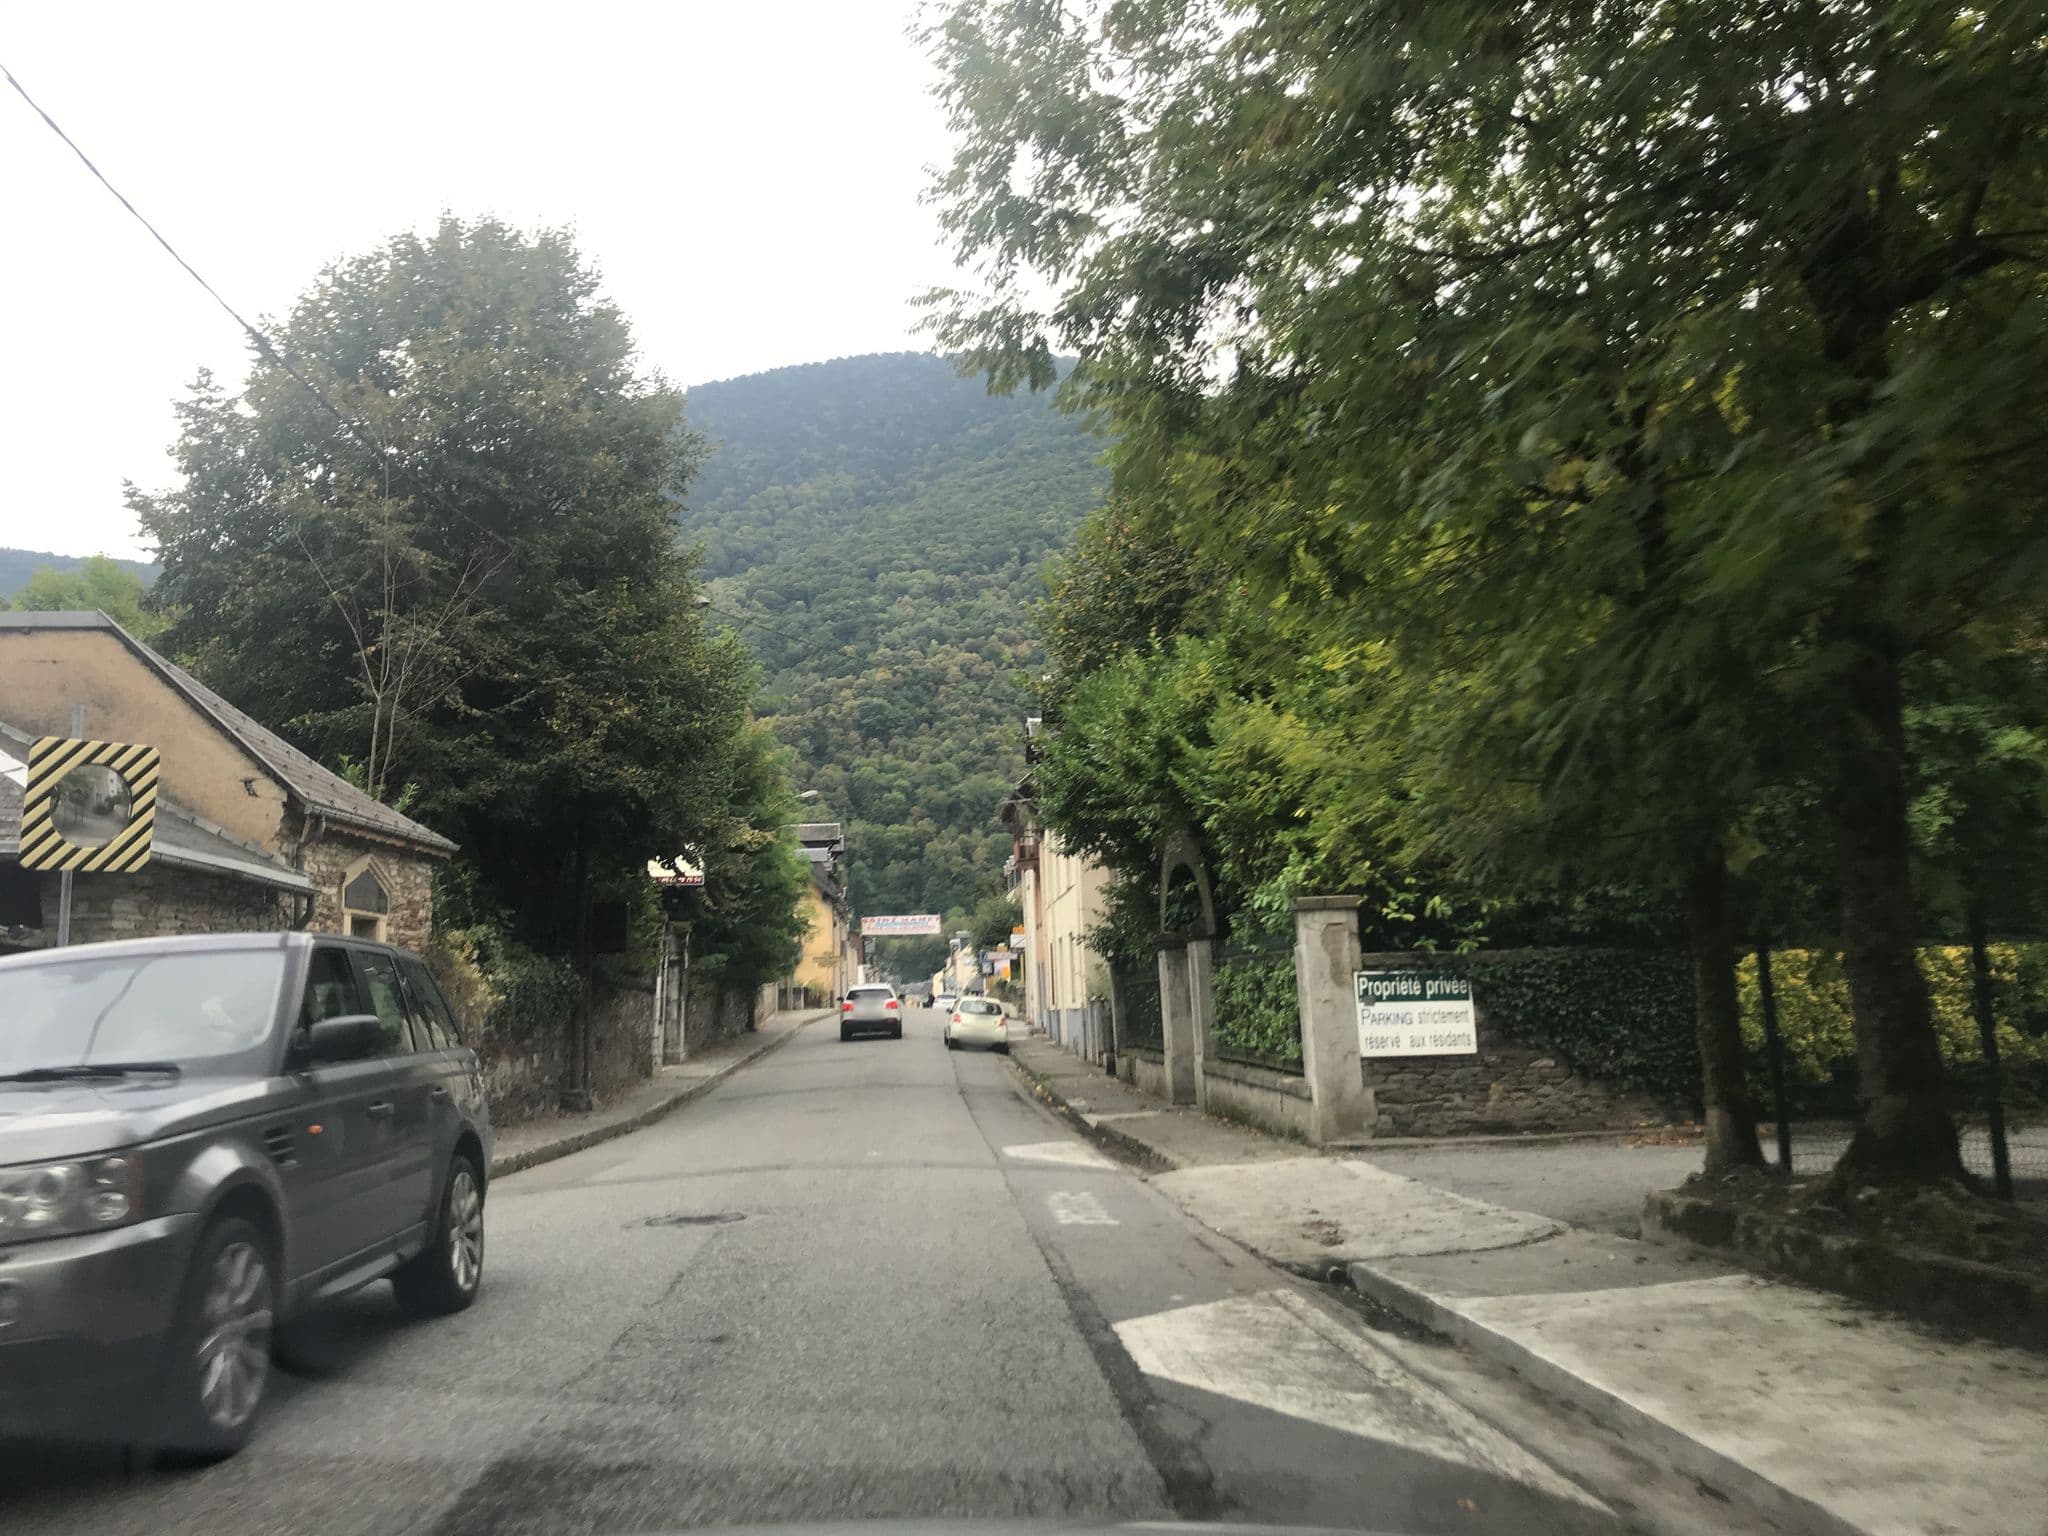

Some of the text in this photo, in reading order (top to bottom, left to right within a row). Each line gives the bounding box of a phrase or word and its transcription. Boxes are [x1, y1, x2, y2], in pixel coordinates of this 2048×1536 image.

[1359, 975, 1468, 1000] Propriété privée
[1361, 1008, 1470, 1025] PARKING strictement
[1365, 1032, 1401, 1050] réservé
[1409, 1034, 1425, 1048] aux
